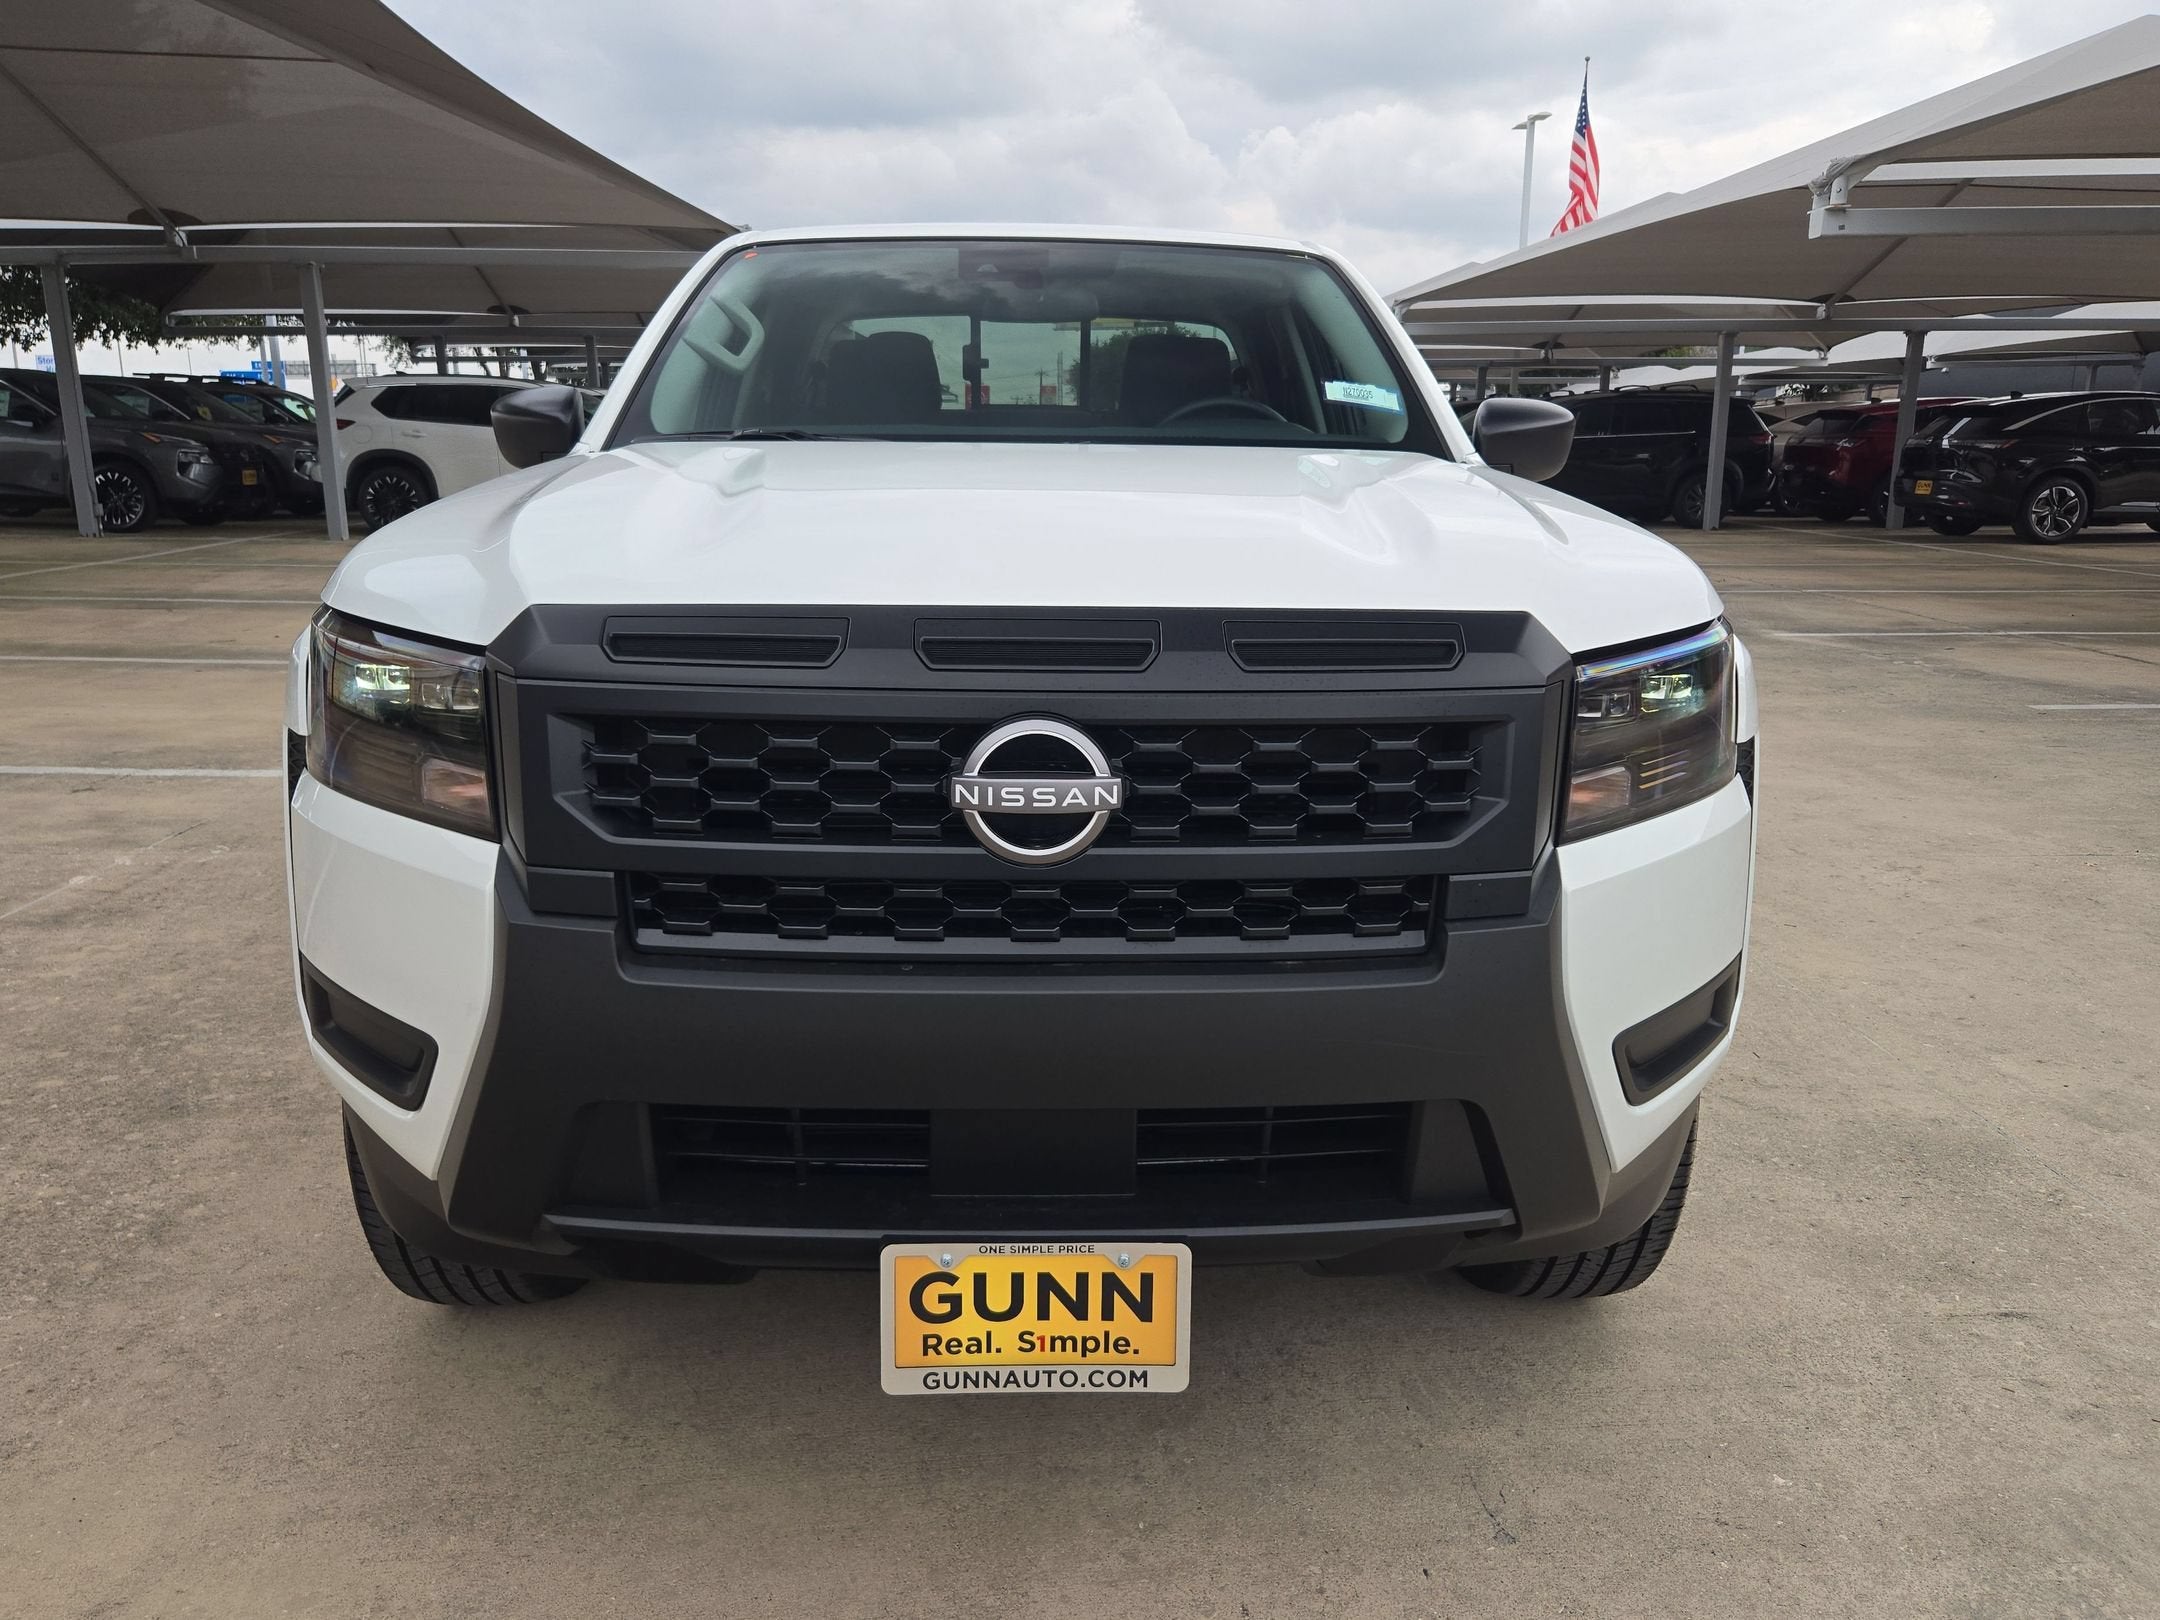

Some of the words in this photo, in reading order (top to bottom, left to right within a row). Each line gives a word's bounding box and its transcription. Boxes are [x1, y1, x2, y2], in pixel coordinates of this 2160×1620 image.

[955, 784, 1118, 807] NISSAN
[979, 1245, 1005, 1254] ONE
[1010, 1245, 1054, 1254] SIMPLE
[1058, 1244, 1095, 1253] PRICE
[909, 1271, 1153, 1324] GUNN
[922, 1330, 1002, 1357] Real.
[922, 1370, 1148, 1390] GUNNAUTO.COM
